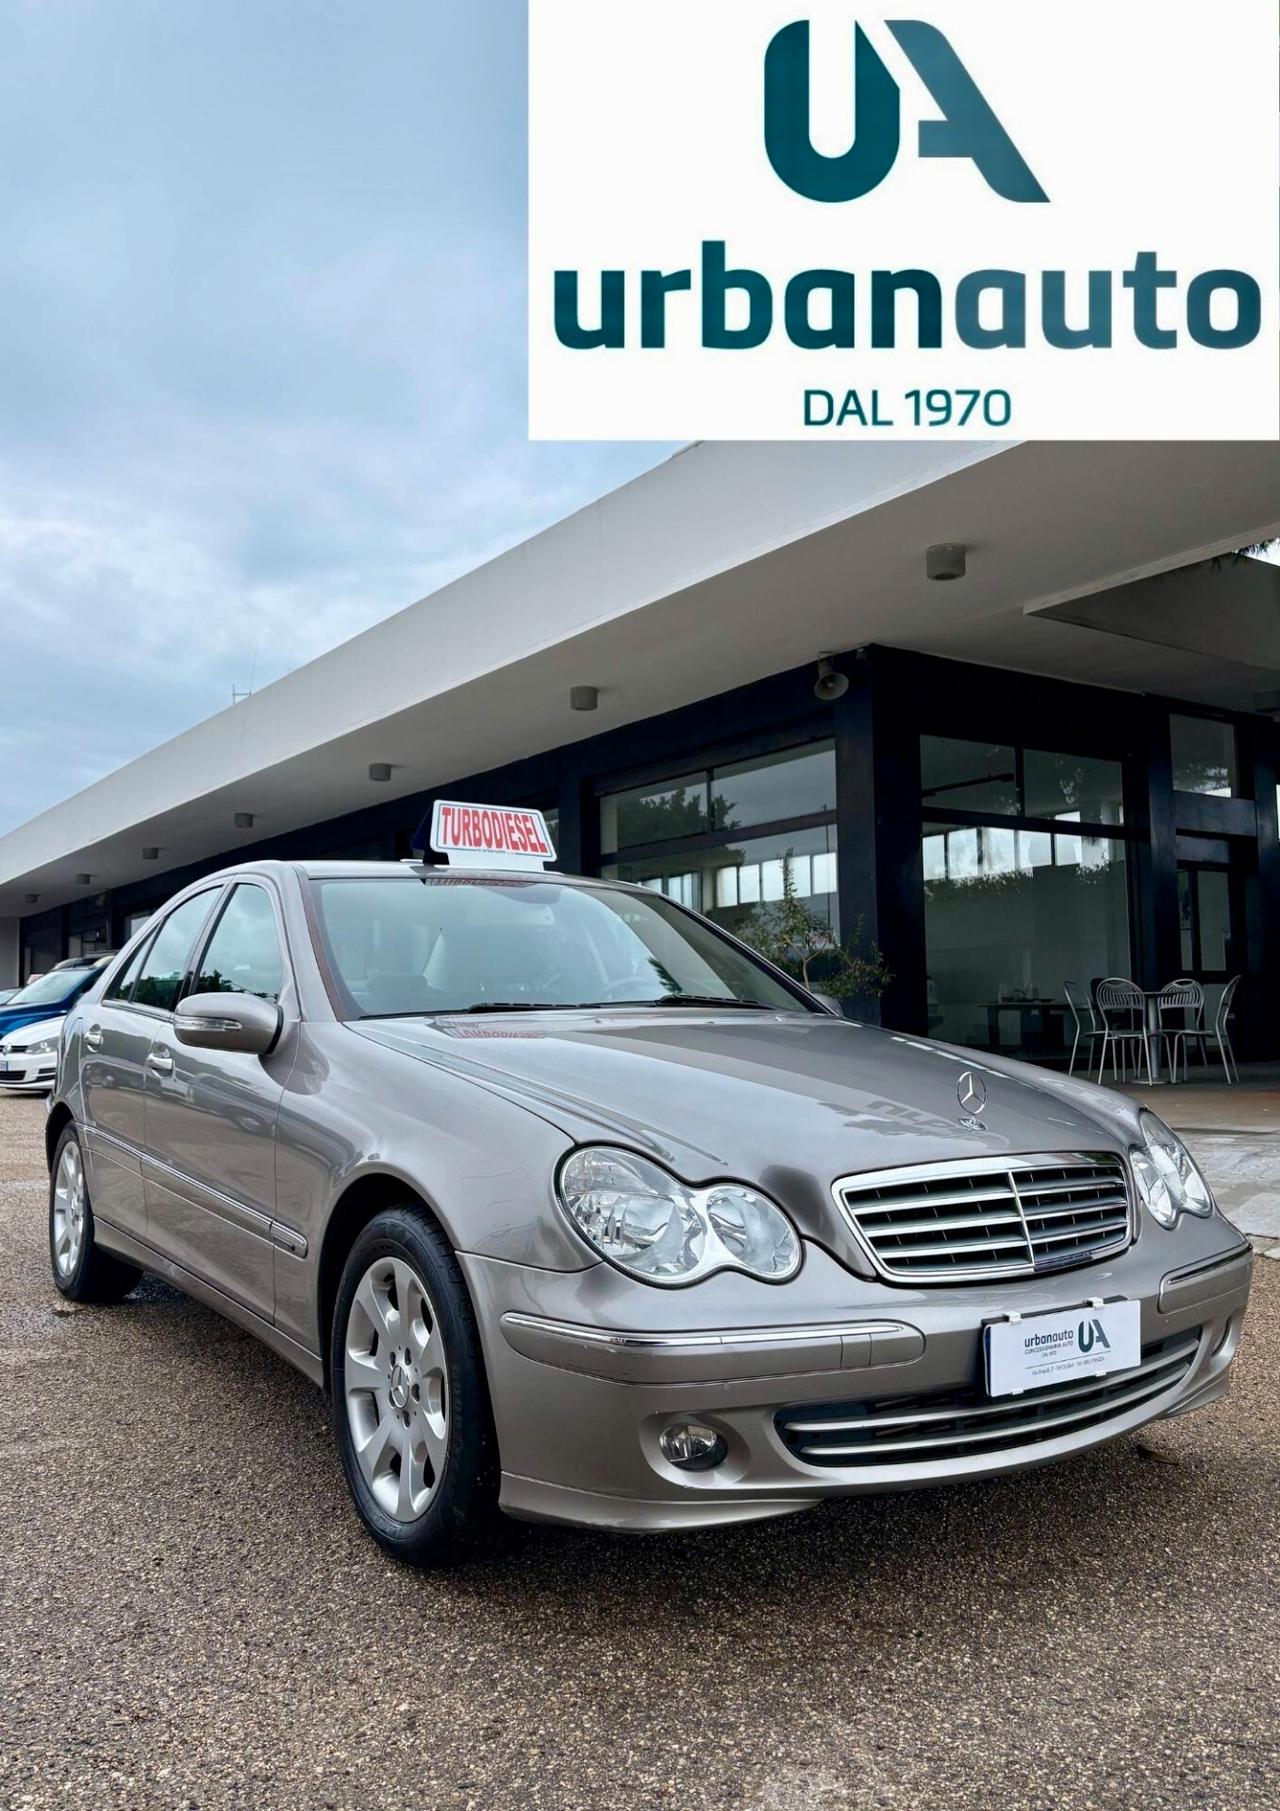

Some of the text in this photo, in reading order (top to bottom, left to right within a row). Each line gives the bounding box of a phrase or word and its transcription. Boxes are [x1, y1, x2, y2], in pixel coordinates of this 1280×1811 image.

[441, 806, 549, 853] TURBODIESEL
[1024, 1329, 1074, 1348] urbanauto
[1078, 1318, 1111, 1353] UA
